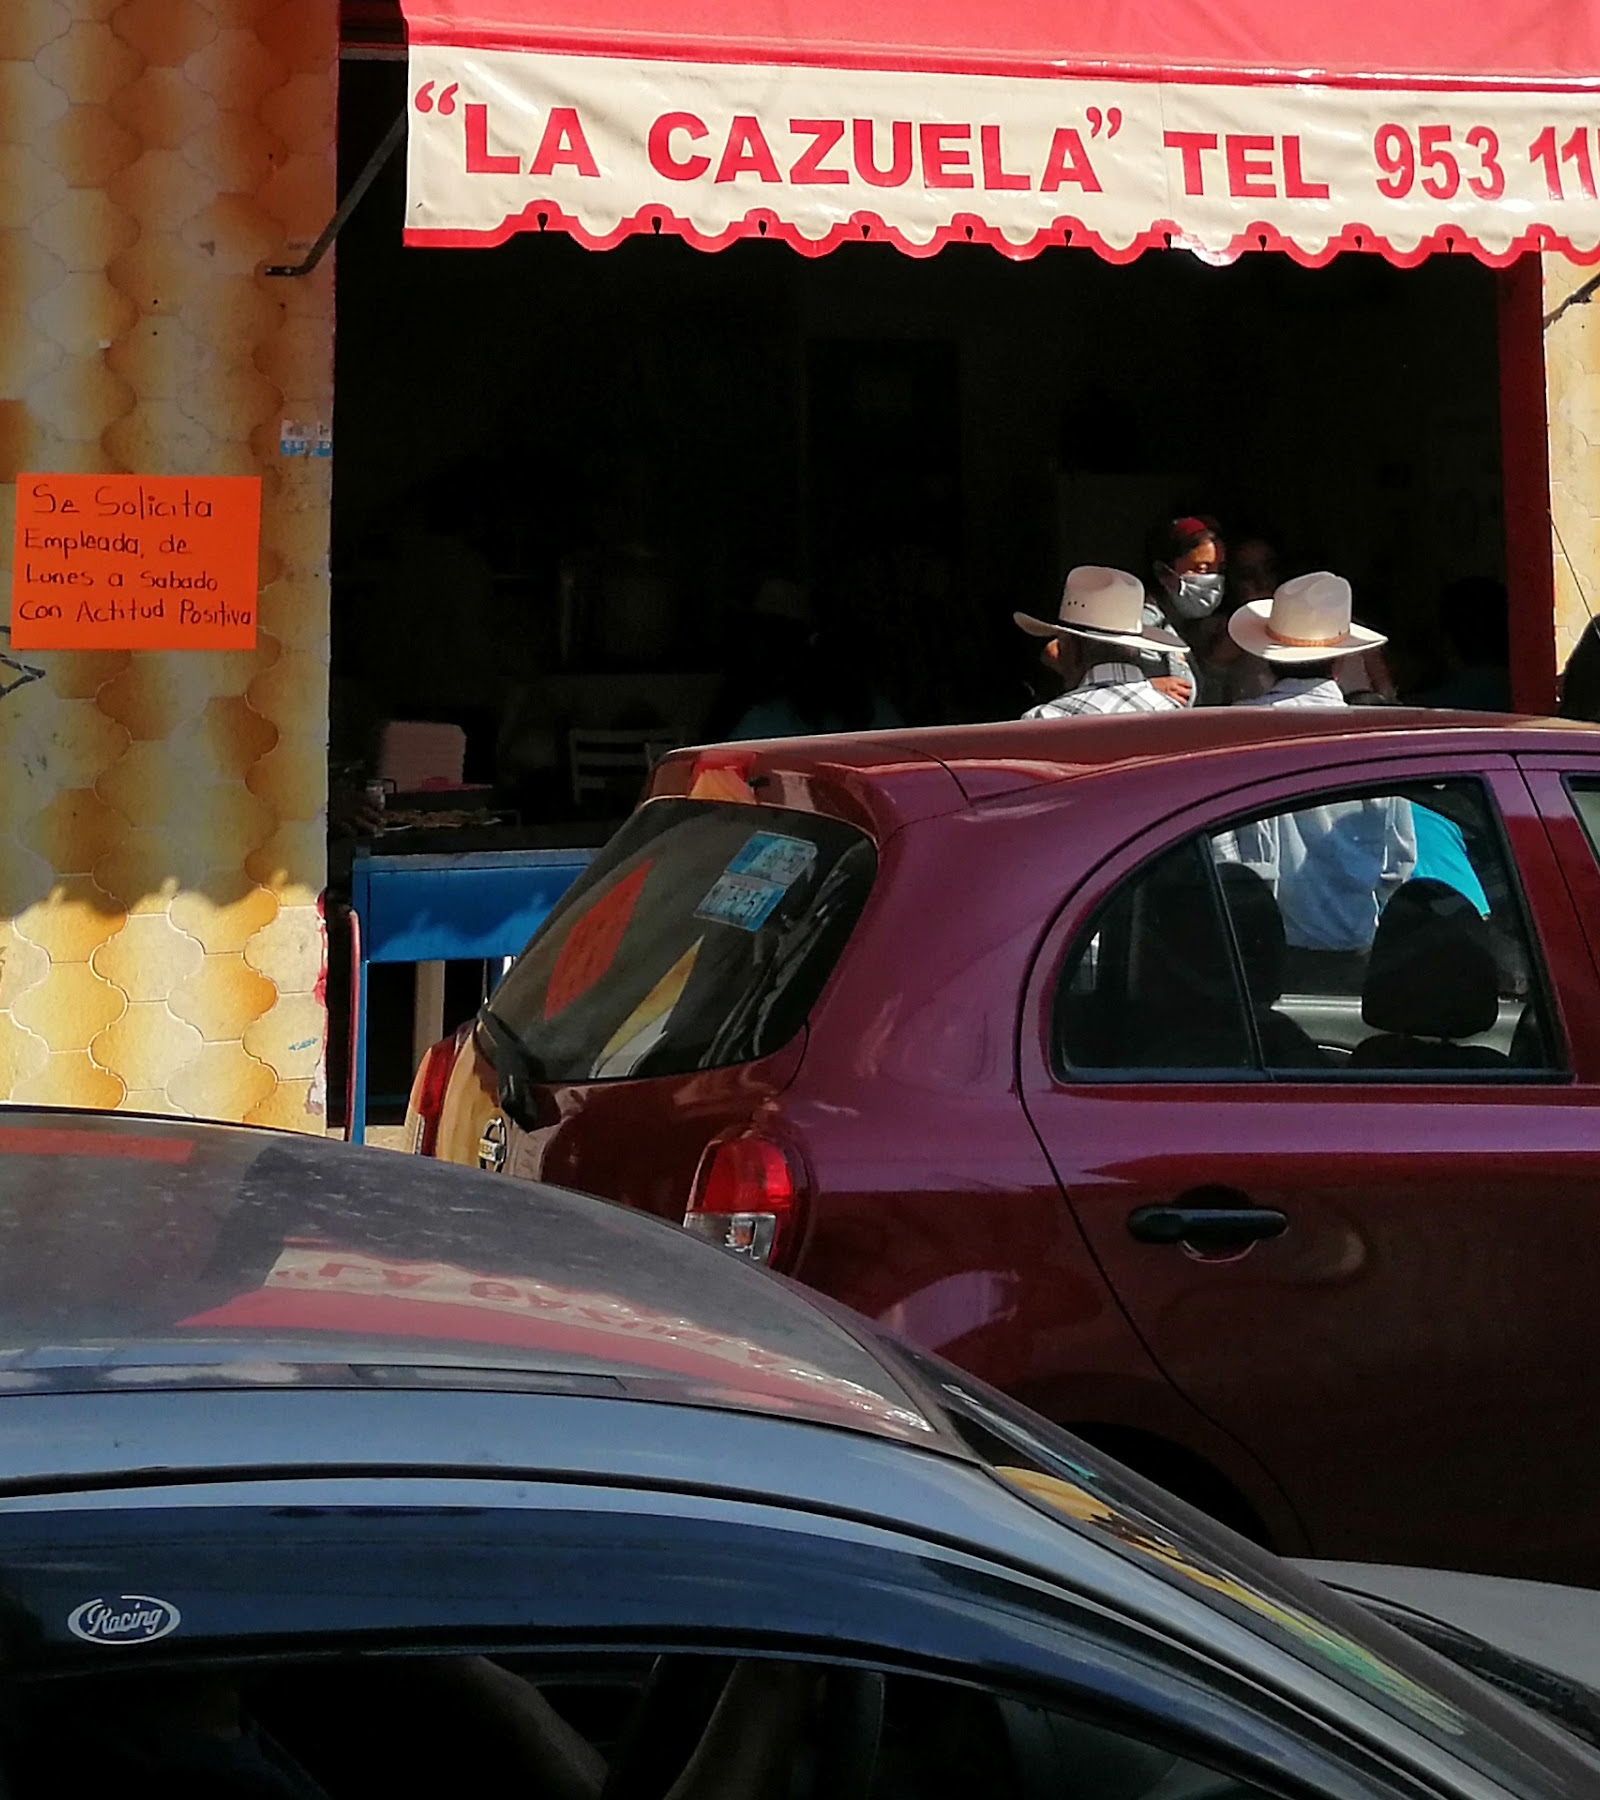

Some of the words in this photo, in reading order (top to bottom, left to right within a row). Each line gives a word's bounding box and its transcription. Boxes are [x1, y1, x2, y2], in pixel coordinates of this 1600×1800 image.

[1163, 130, 1330, 200] TEL
[1373, 123, 1505, 200] 953
[32, 484, 81, 515] Se
[94, 485, 212, 520] Solicita
[158, 534, 192, 555] de
[26, 563, 94, 586] Lunes
[108, 572, 124, 587] a
[76, 598, 165, 623] Actitud
[179, 599, 252, 627] Positiva
[87, 1600, 164, 1636] Racing
